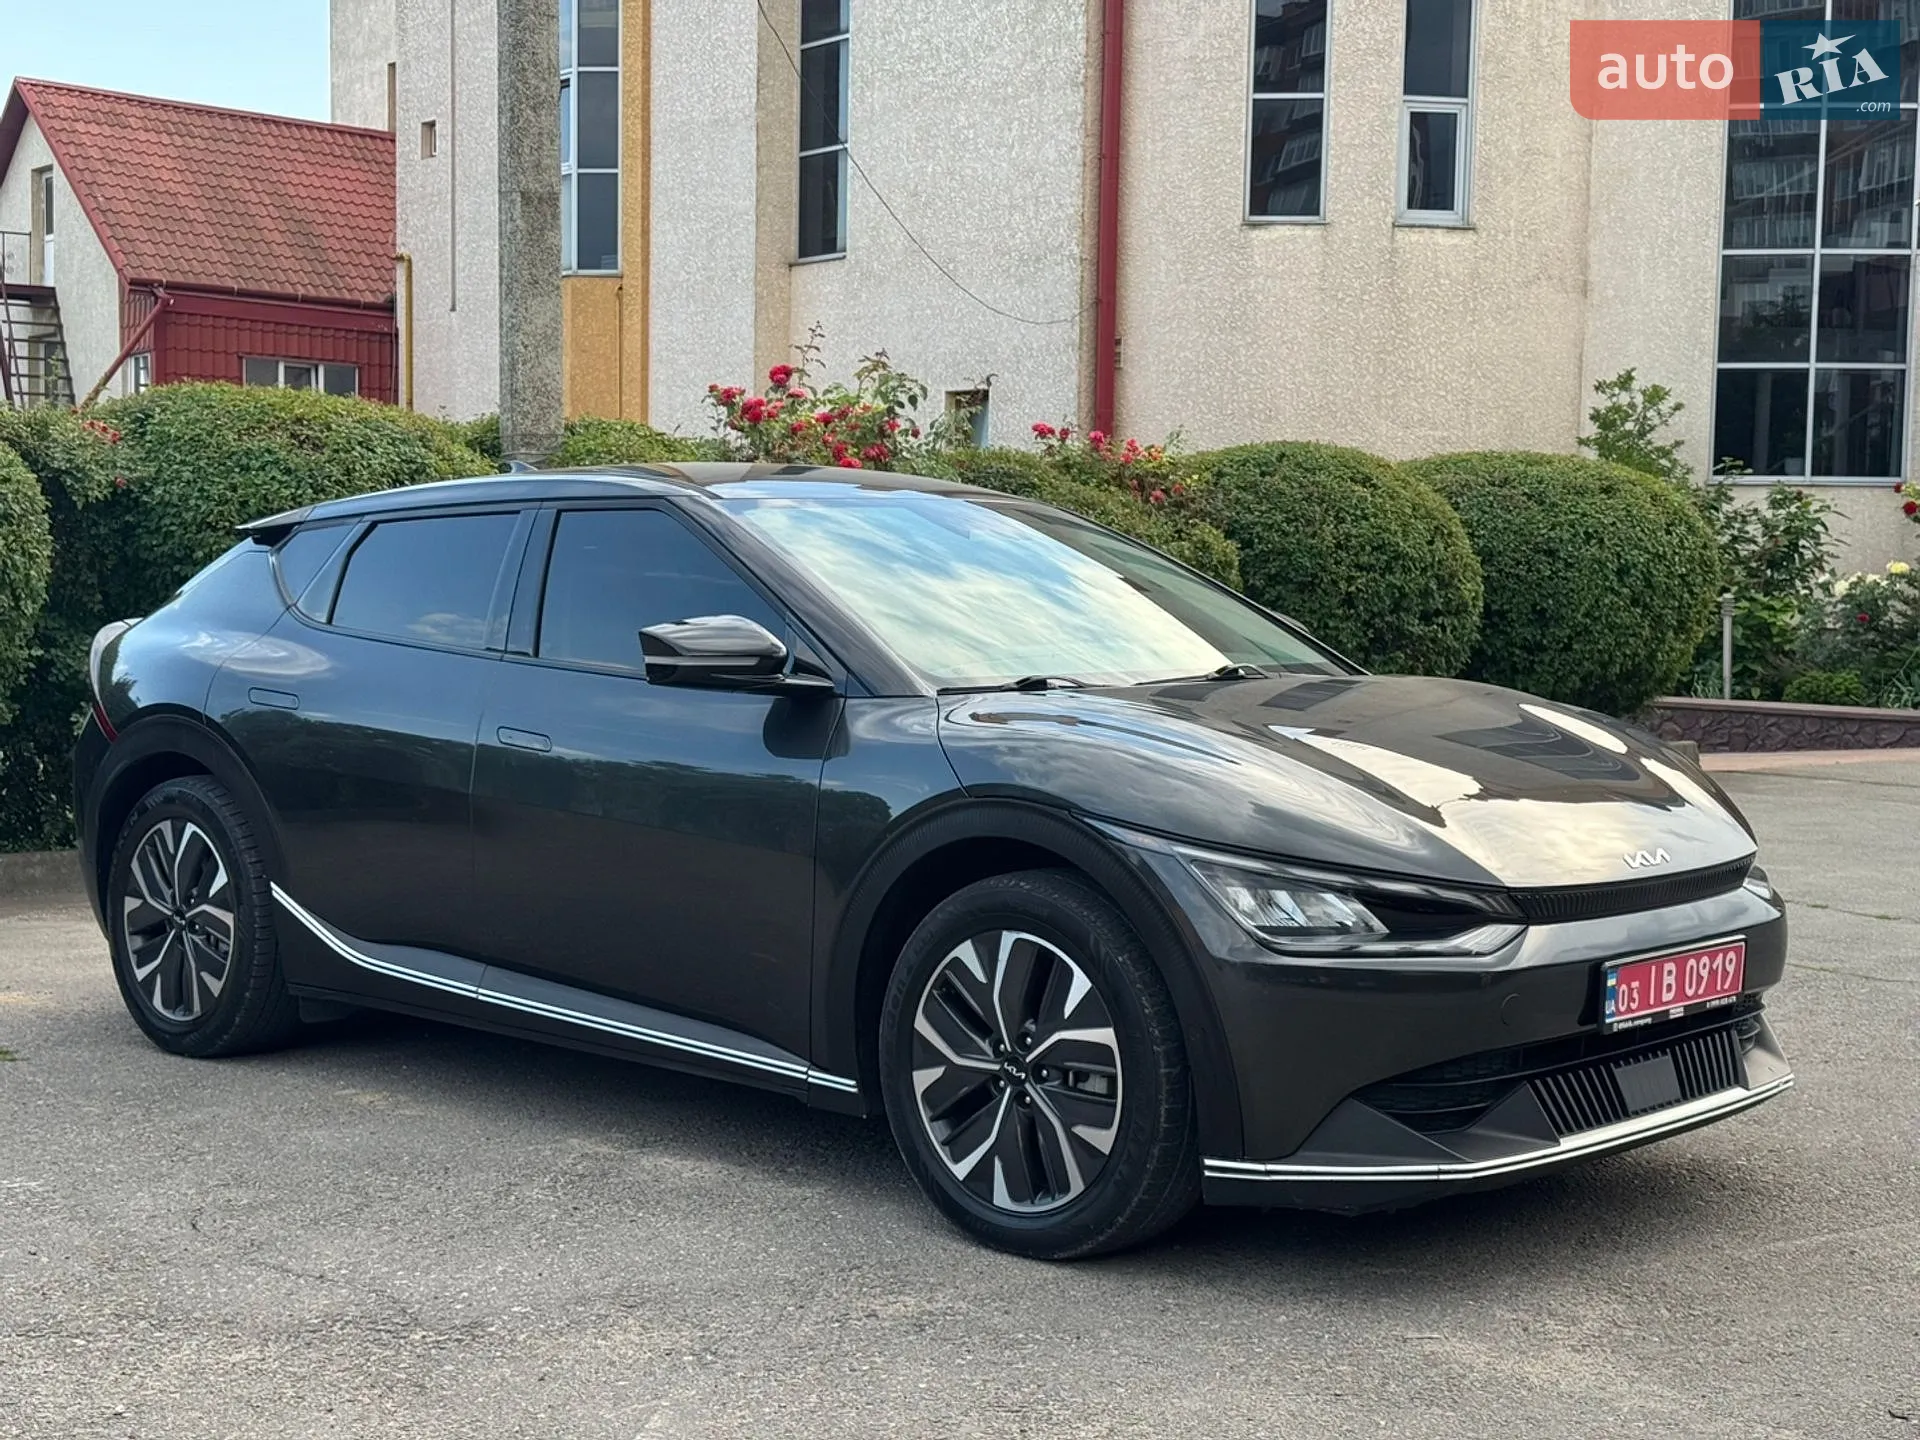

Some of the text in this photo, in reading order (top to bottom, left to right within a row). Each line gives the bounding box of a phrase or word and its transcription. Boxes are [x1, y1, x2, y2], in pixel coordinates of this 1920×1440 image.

[1618, 951, 1736, 1012] 03 IB 0919
[1605, 999, 1616, 1014] UA
